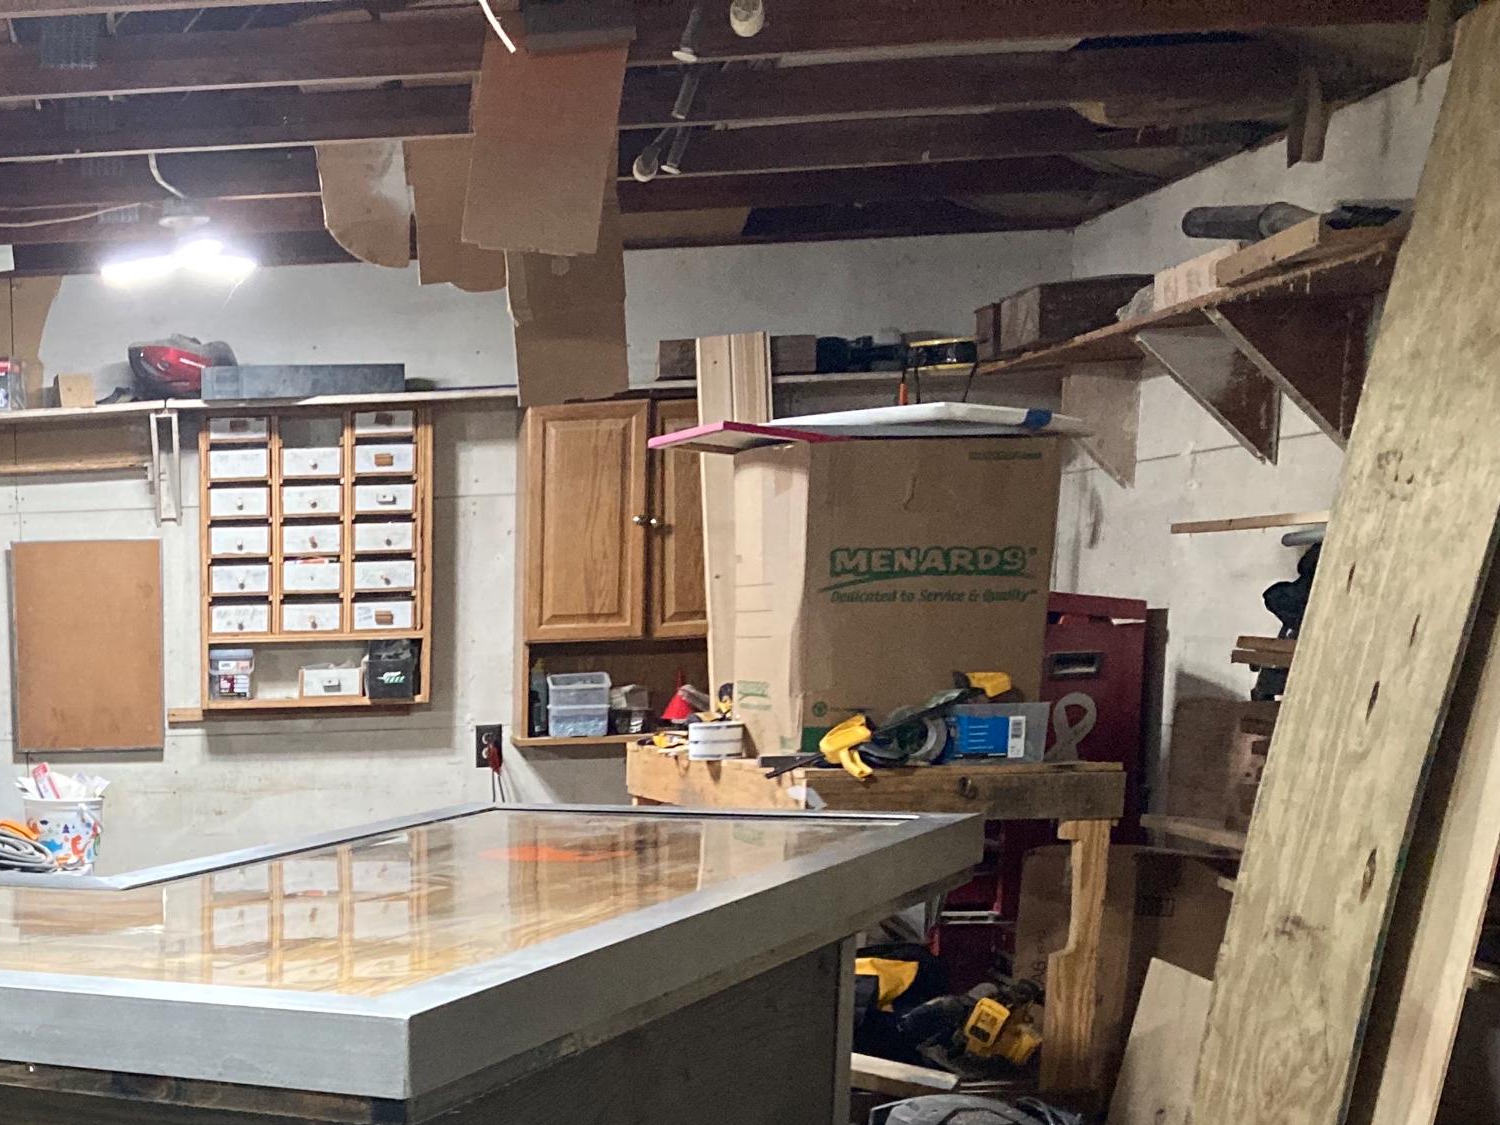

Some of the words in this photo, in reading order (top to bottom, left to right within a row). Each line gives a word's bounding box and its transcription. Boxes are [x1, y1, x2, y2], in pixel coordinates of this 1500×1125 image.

[831, 547, 1026, 575] MENARDS
[831, 589, 896, 603] Dedicated
[900, 590, 915, 602] to
[918, 589, 966, 602] Service
[968, 591, 979, 602] &
